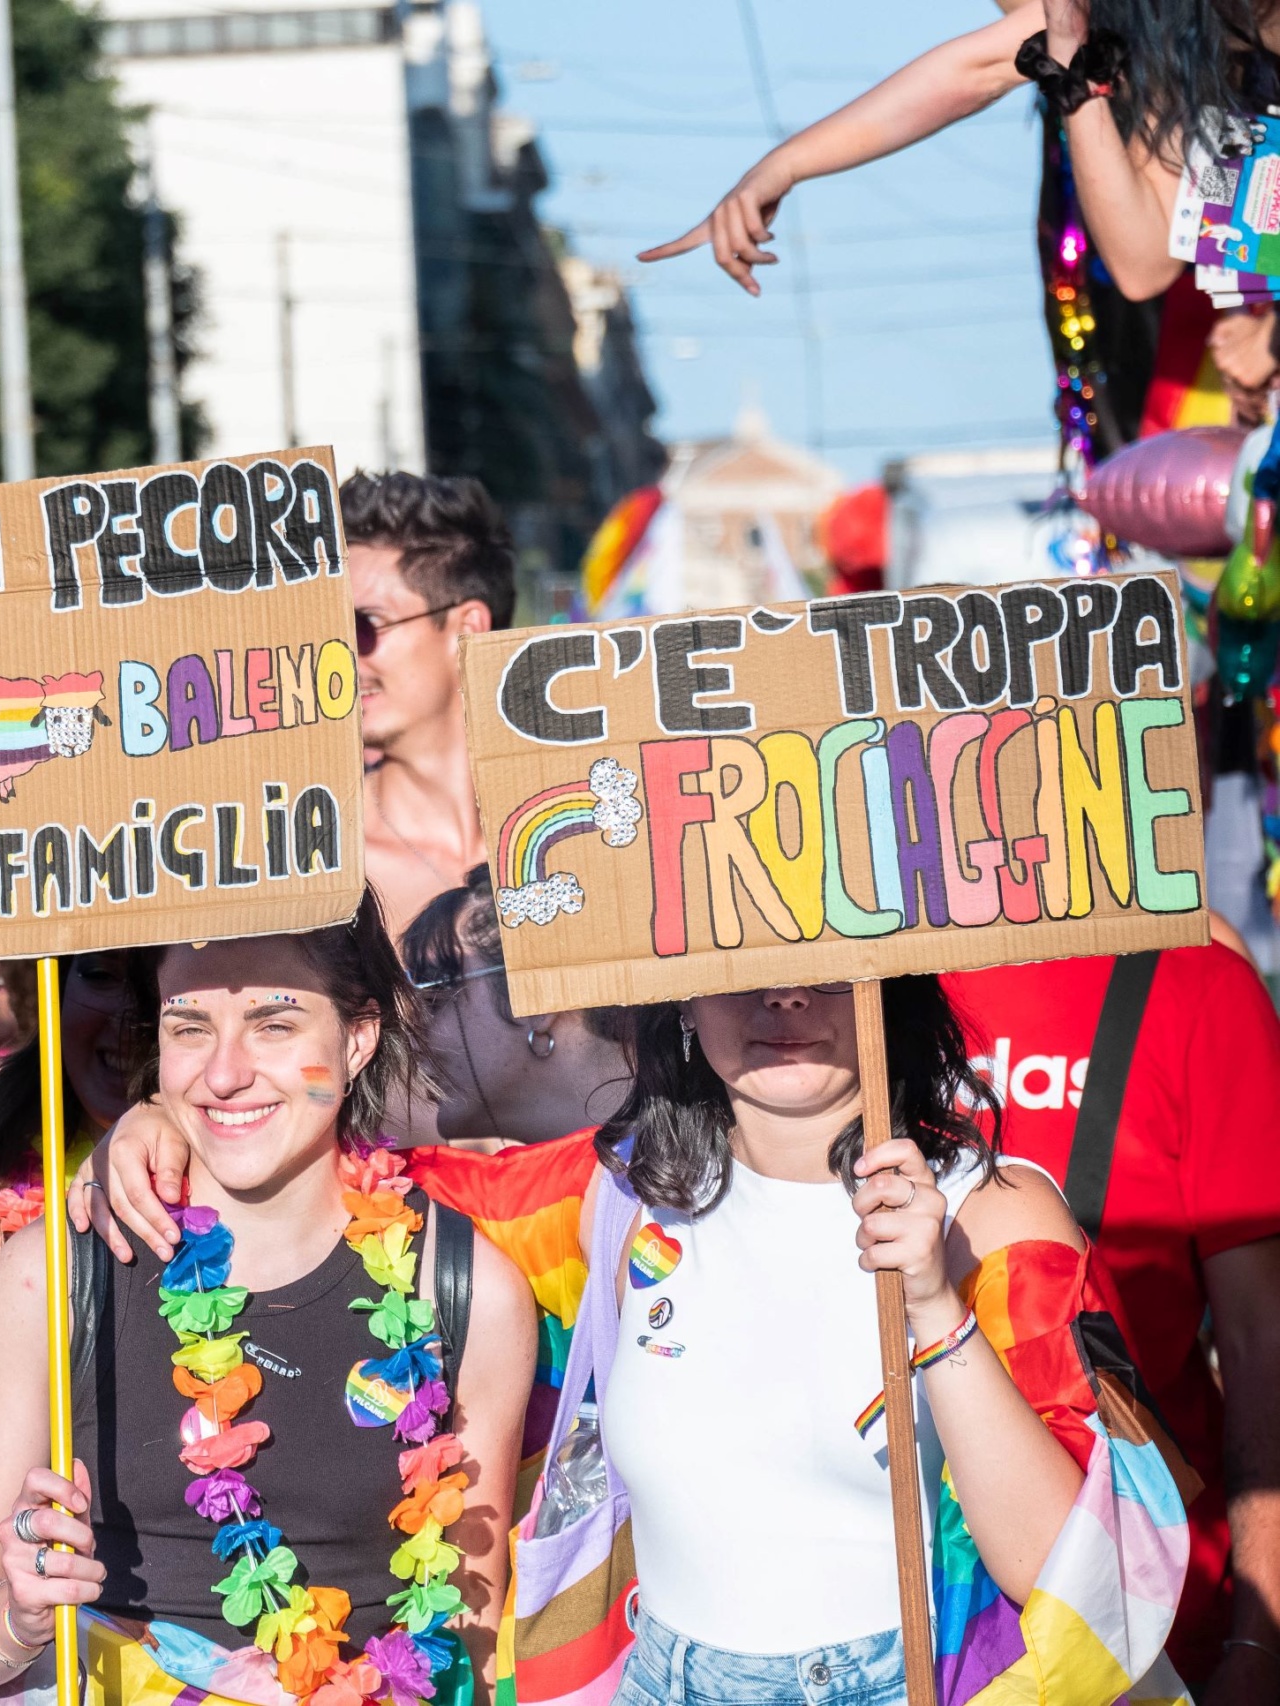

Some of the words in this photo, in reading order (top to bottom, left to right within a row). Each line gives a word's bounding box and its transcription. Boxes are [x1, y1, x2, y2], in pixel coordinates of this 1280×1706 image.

[40, 458, 343, 613] PECORA
[118, 639, 357, 757] BALENO
[806, 576, 1183, 720] TROPPA
[353, 1394, 385, 1420] FILCAMS
